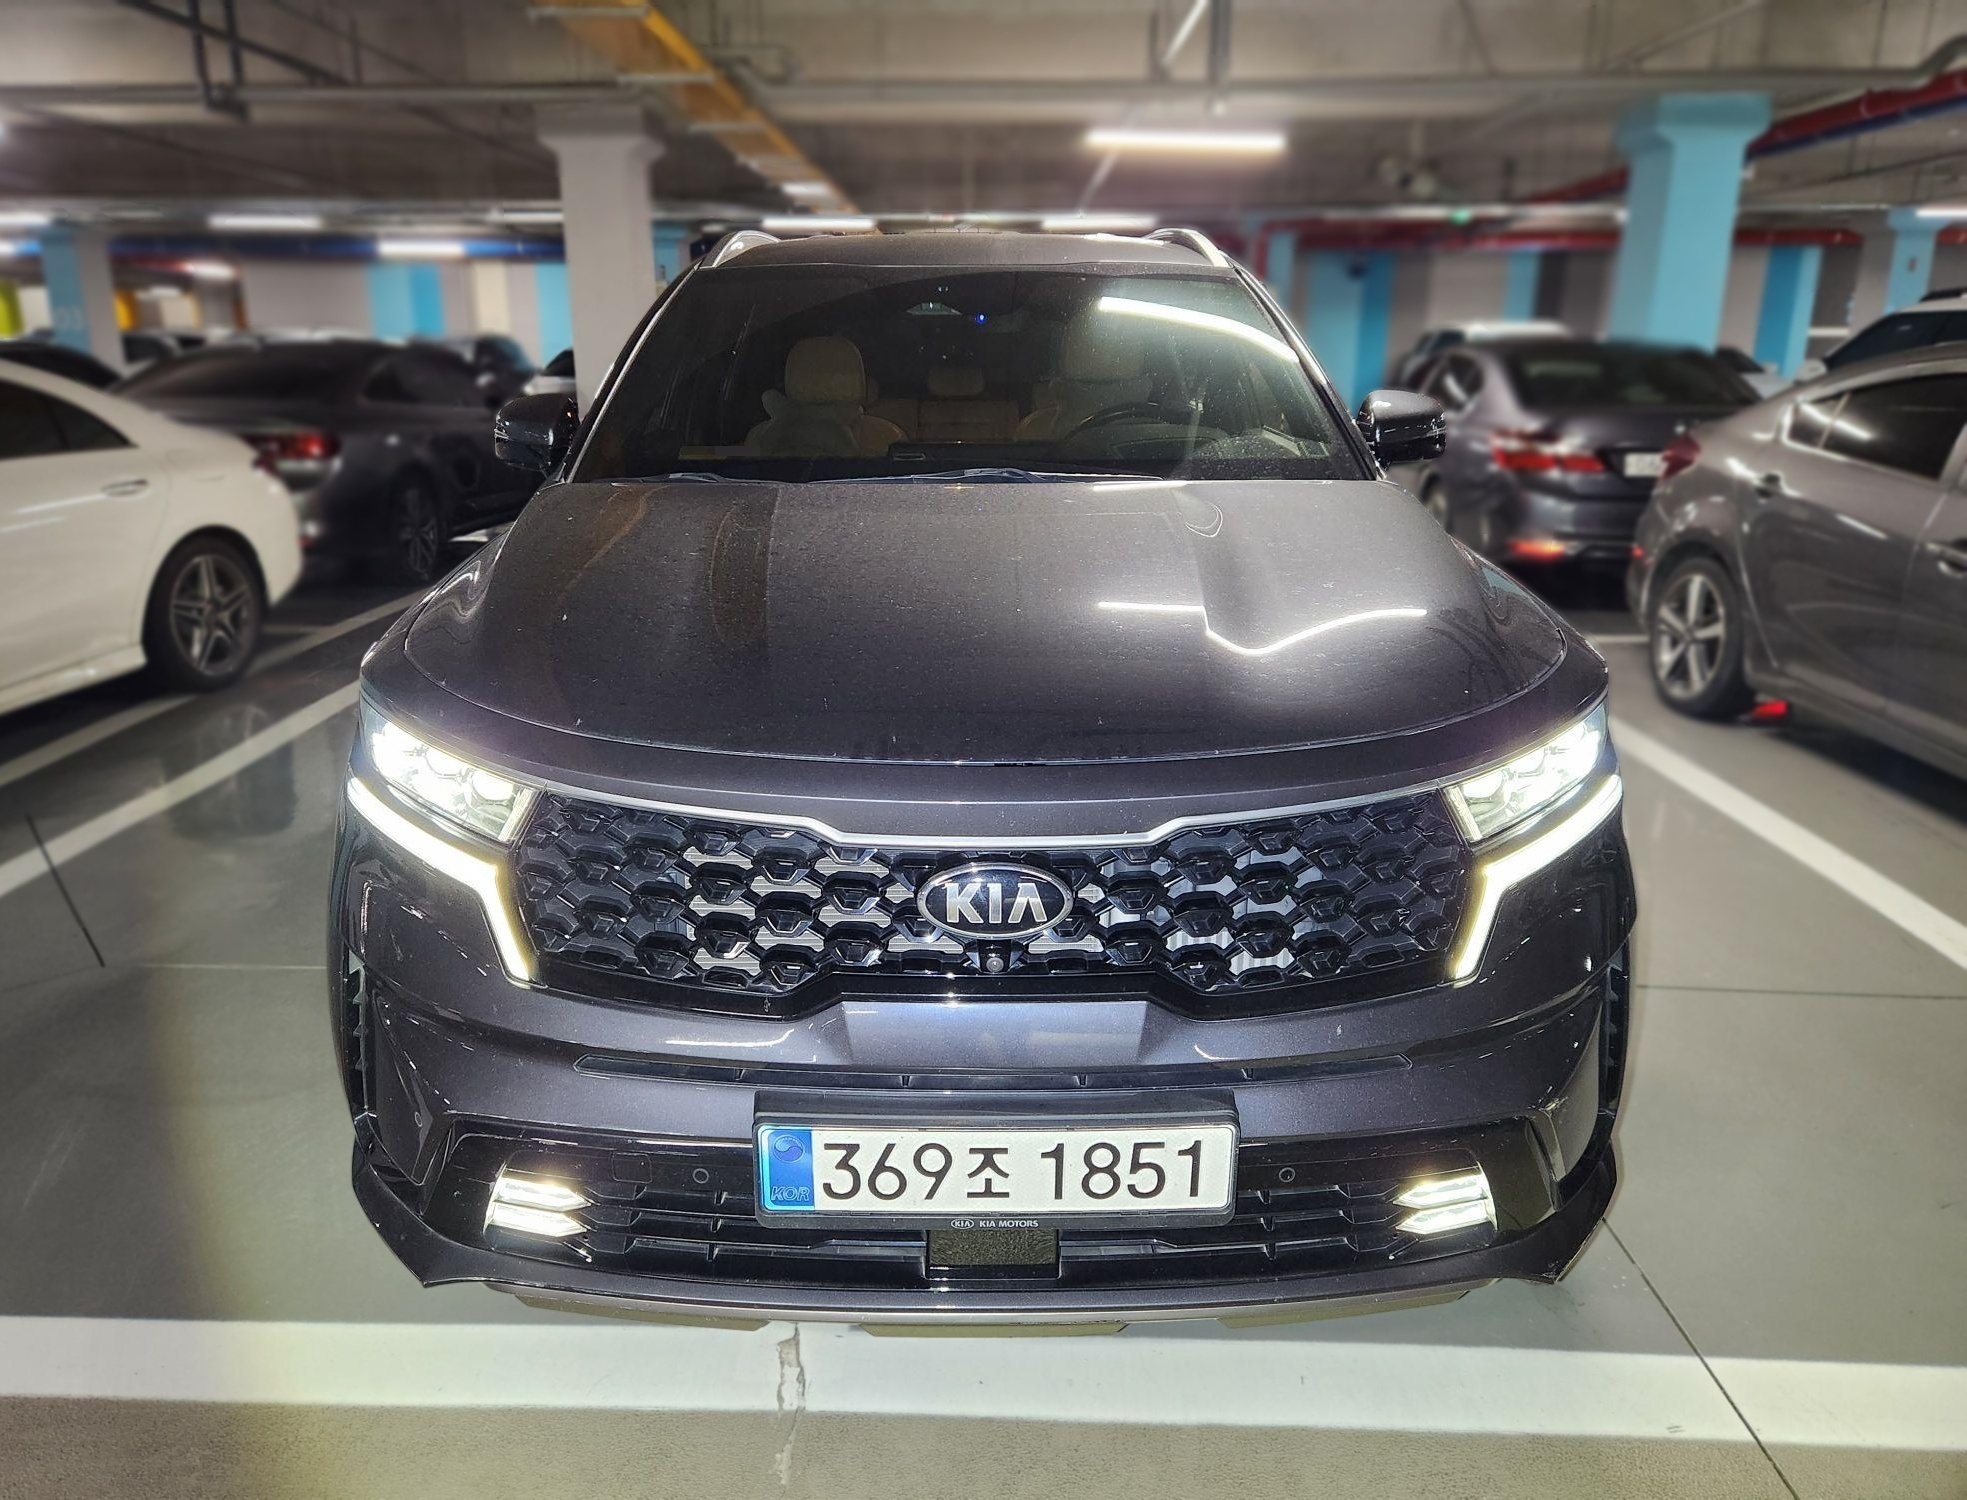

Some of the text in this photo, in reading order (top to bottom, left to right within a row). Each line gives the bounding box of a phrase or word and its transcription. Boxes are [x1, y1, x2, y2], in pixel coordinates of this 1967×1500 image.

[945, 882, 1048, 924] KIA
[822, 1140, 1204, 1200] 369조 1851
[771, 1186, 810, 1201] KOR
[953, 1219, 1039, 1228] KIA KIA MOTORS
